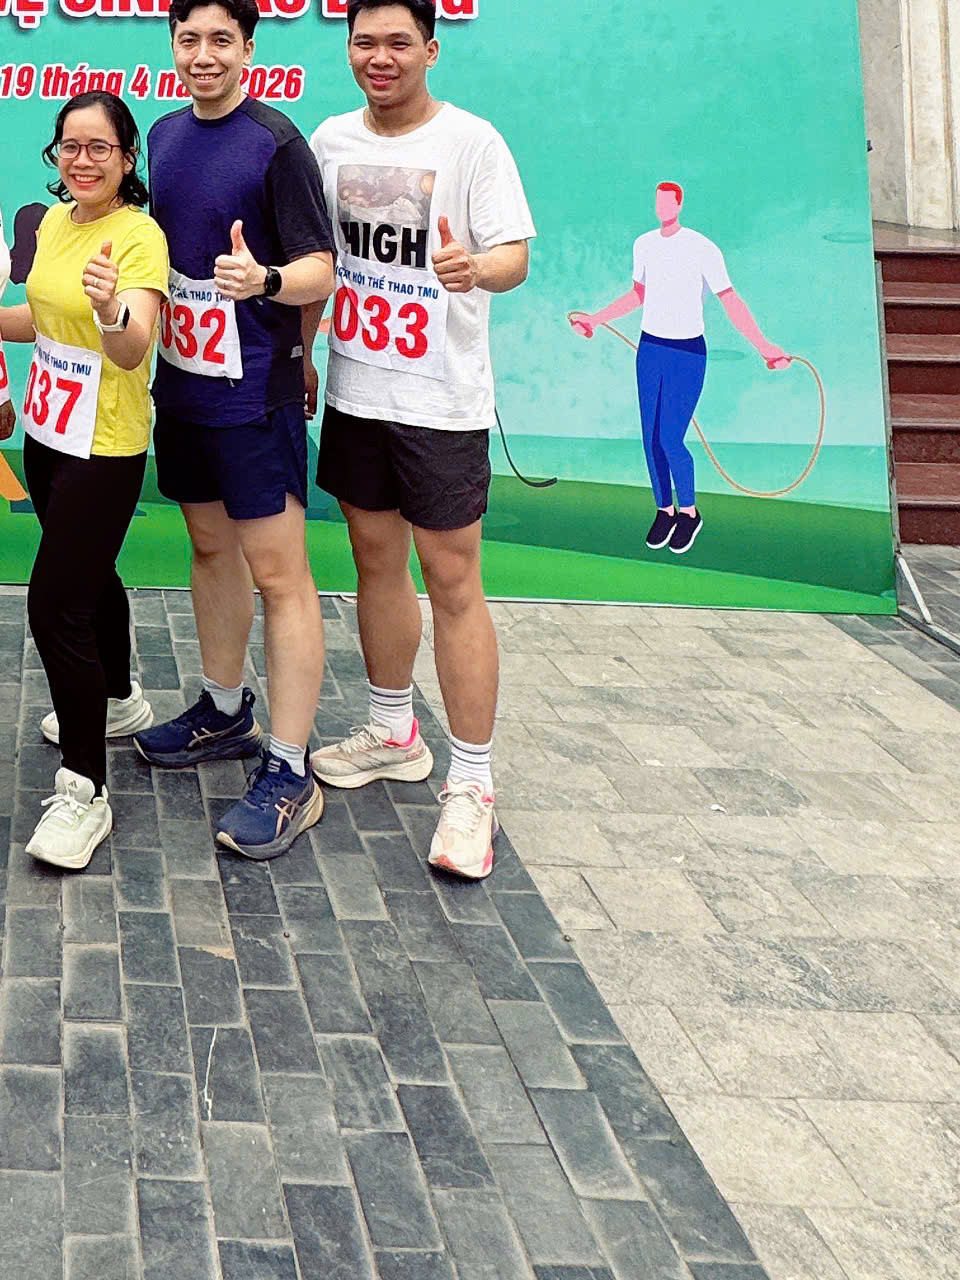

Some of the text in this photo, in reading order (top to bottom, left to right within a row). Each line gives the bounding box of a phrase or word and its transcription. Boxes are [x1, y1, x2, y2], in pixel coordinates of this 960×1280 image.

[2, 65, 34, 97] 19
[41, 65, 123, 98] tháng
[130, 66, 149, 97] 4
[340, 221, 428, 269] HIGH
[189, 290, 212, 302] THAO
[367, 275, 386, 290] THỂ
[387, 280, 414, 295] THAO
[417, 285, 439, 300] TMU
[159, 304, 226, 365] 032
[333, 284, 429, 359] 033
[71, 361, 92, 376] TMU
[24, 361, 83, 436] 037
